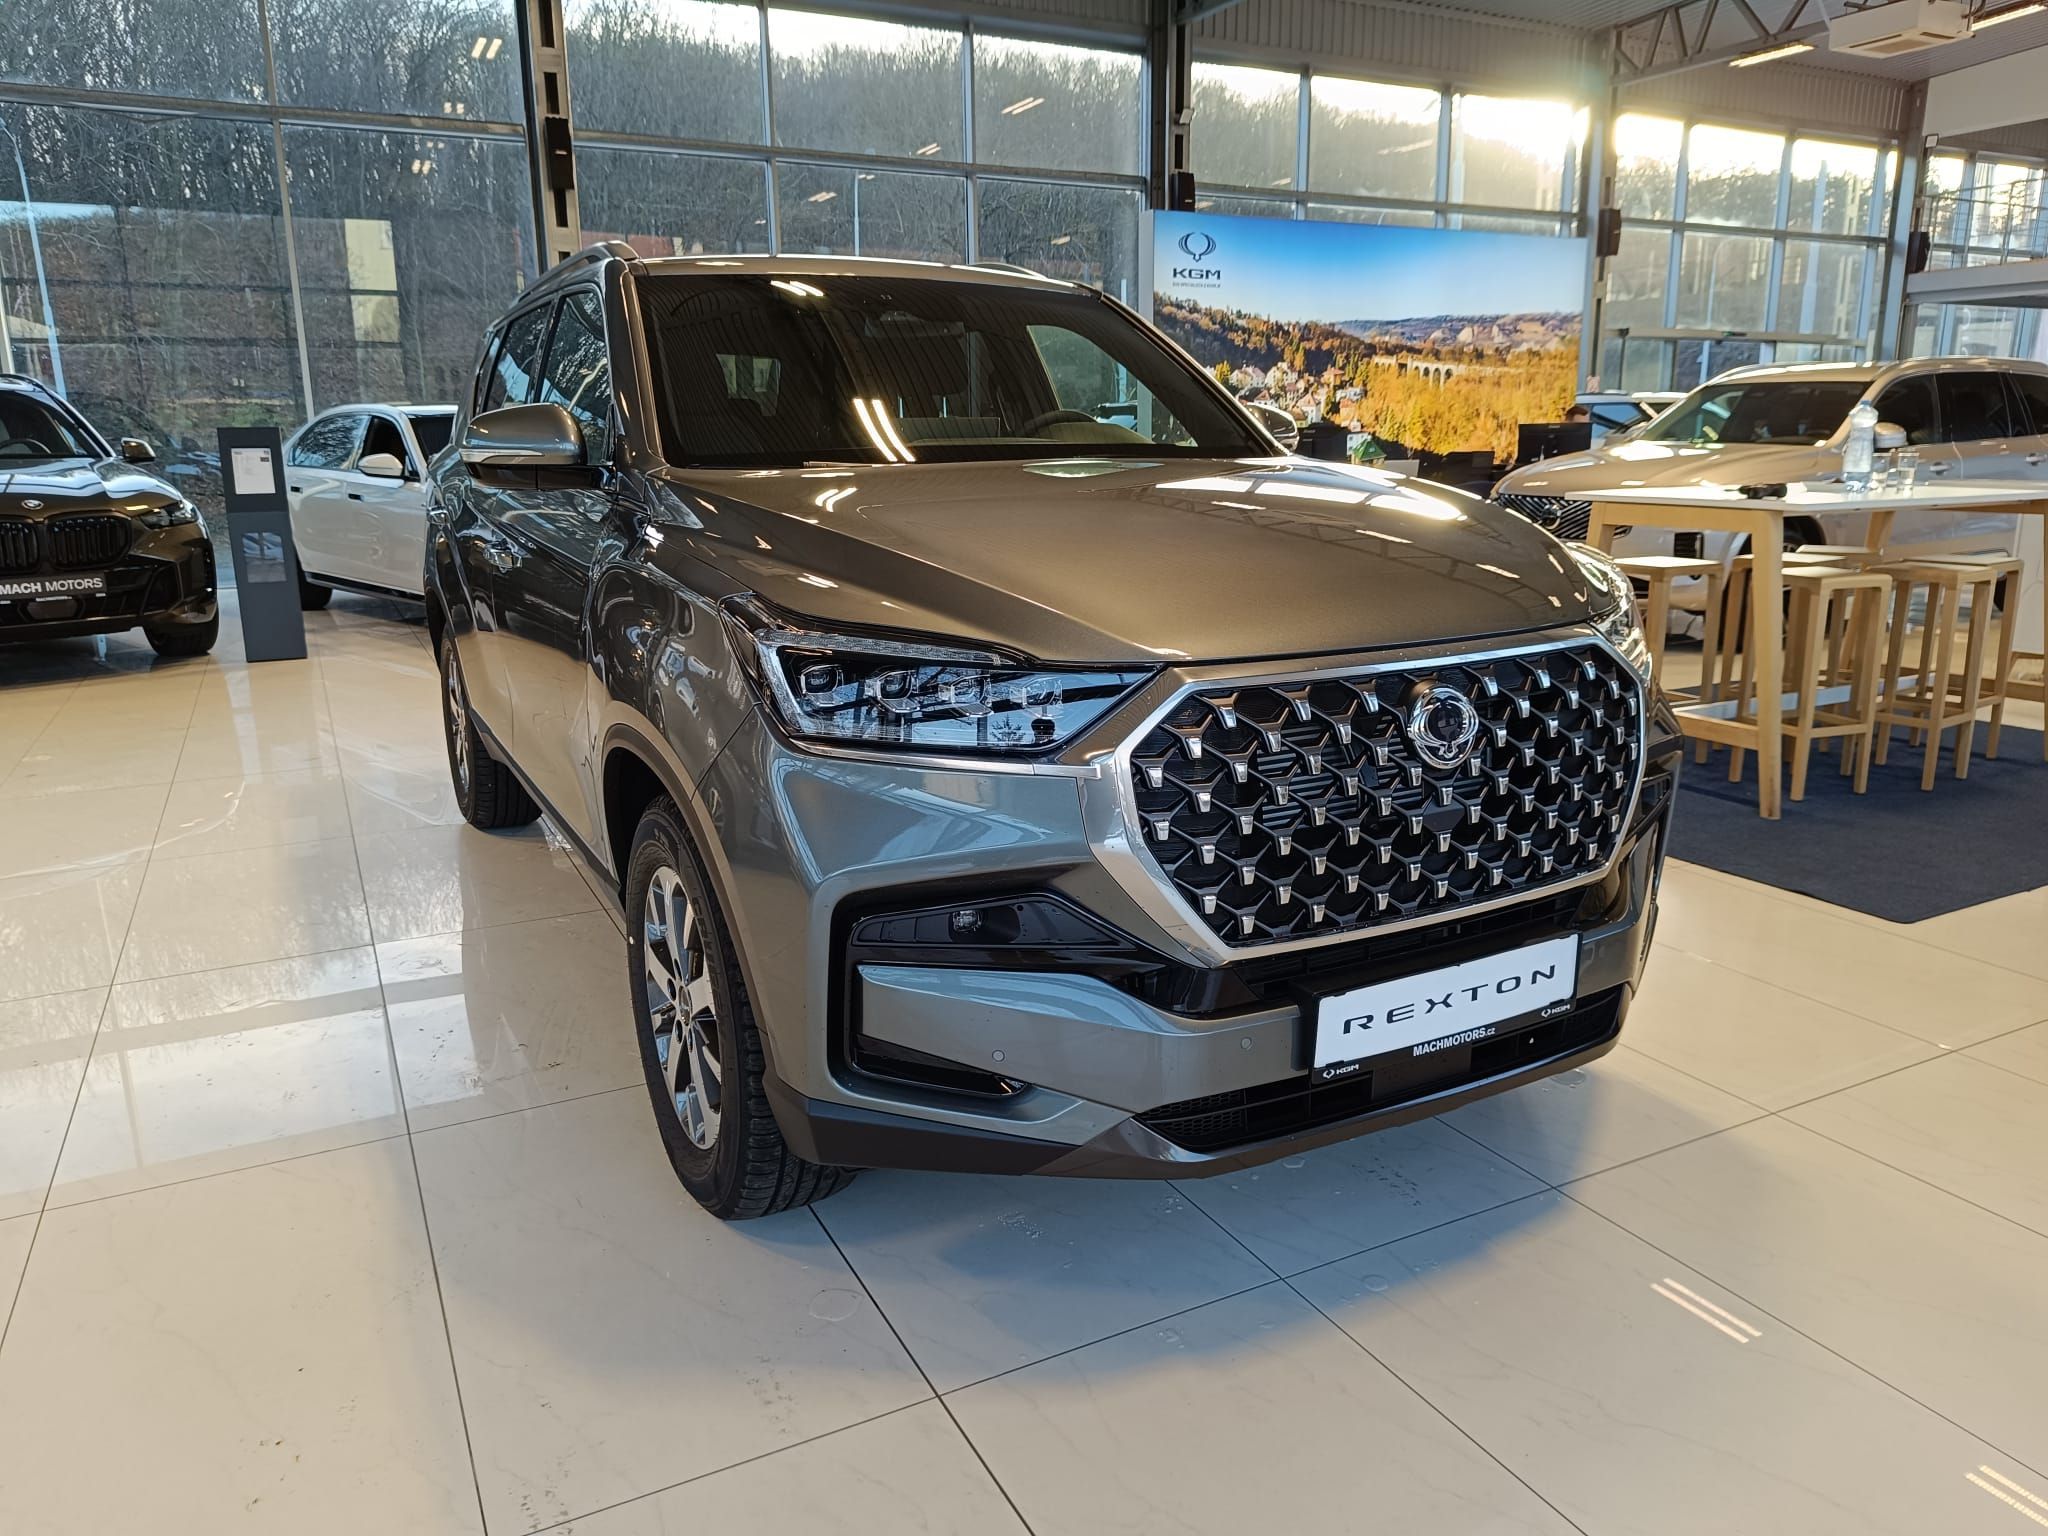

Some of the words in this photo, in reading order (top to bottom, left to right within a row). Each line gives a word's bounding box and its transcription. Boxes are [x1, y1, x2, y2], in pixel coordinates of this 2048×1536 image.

[1173, 268, 1221, 280] KGM
[0, 582, 42, 595] MACH
[45, 578, 103, 592] MOTORS
[1342, 964, 1556, 1035] REXTON
[1413, 1027, 1496, 1057] MACHMOTORS.cz
[1336, 1064, 1360, 1075] KGM
